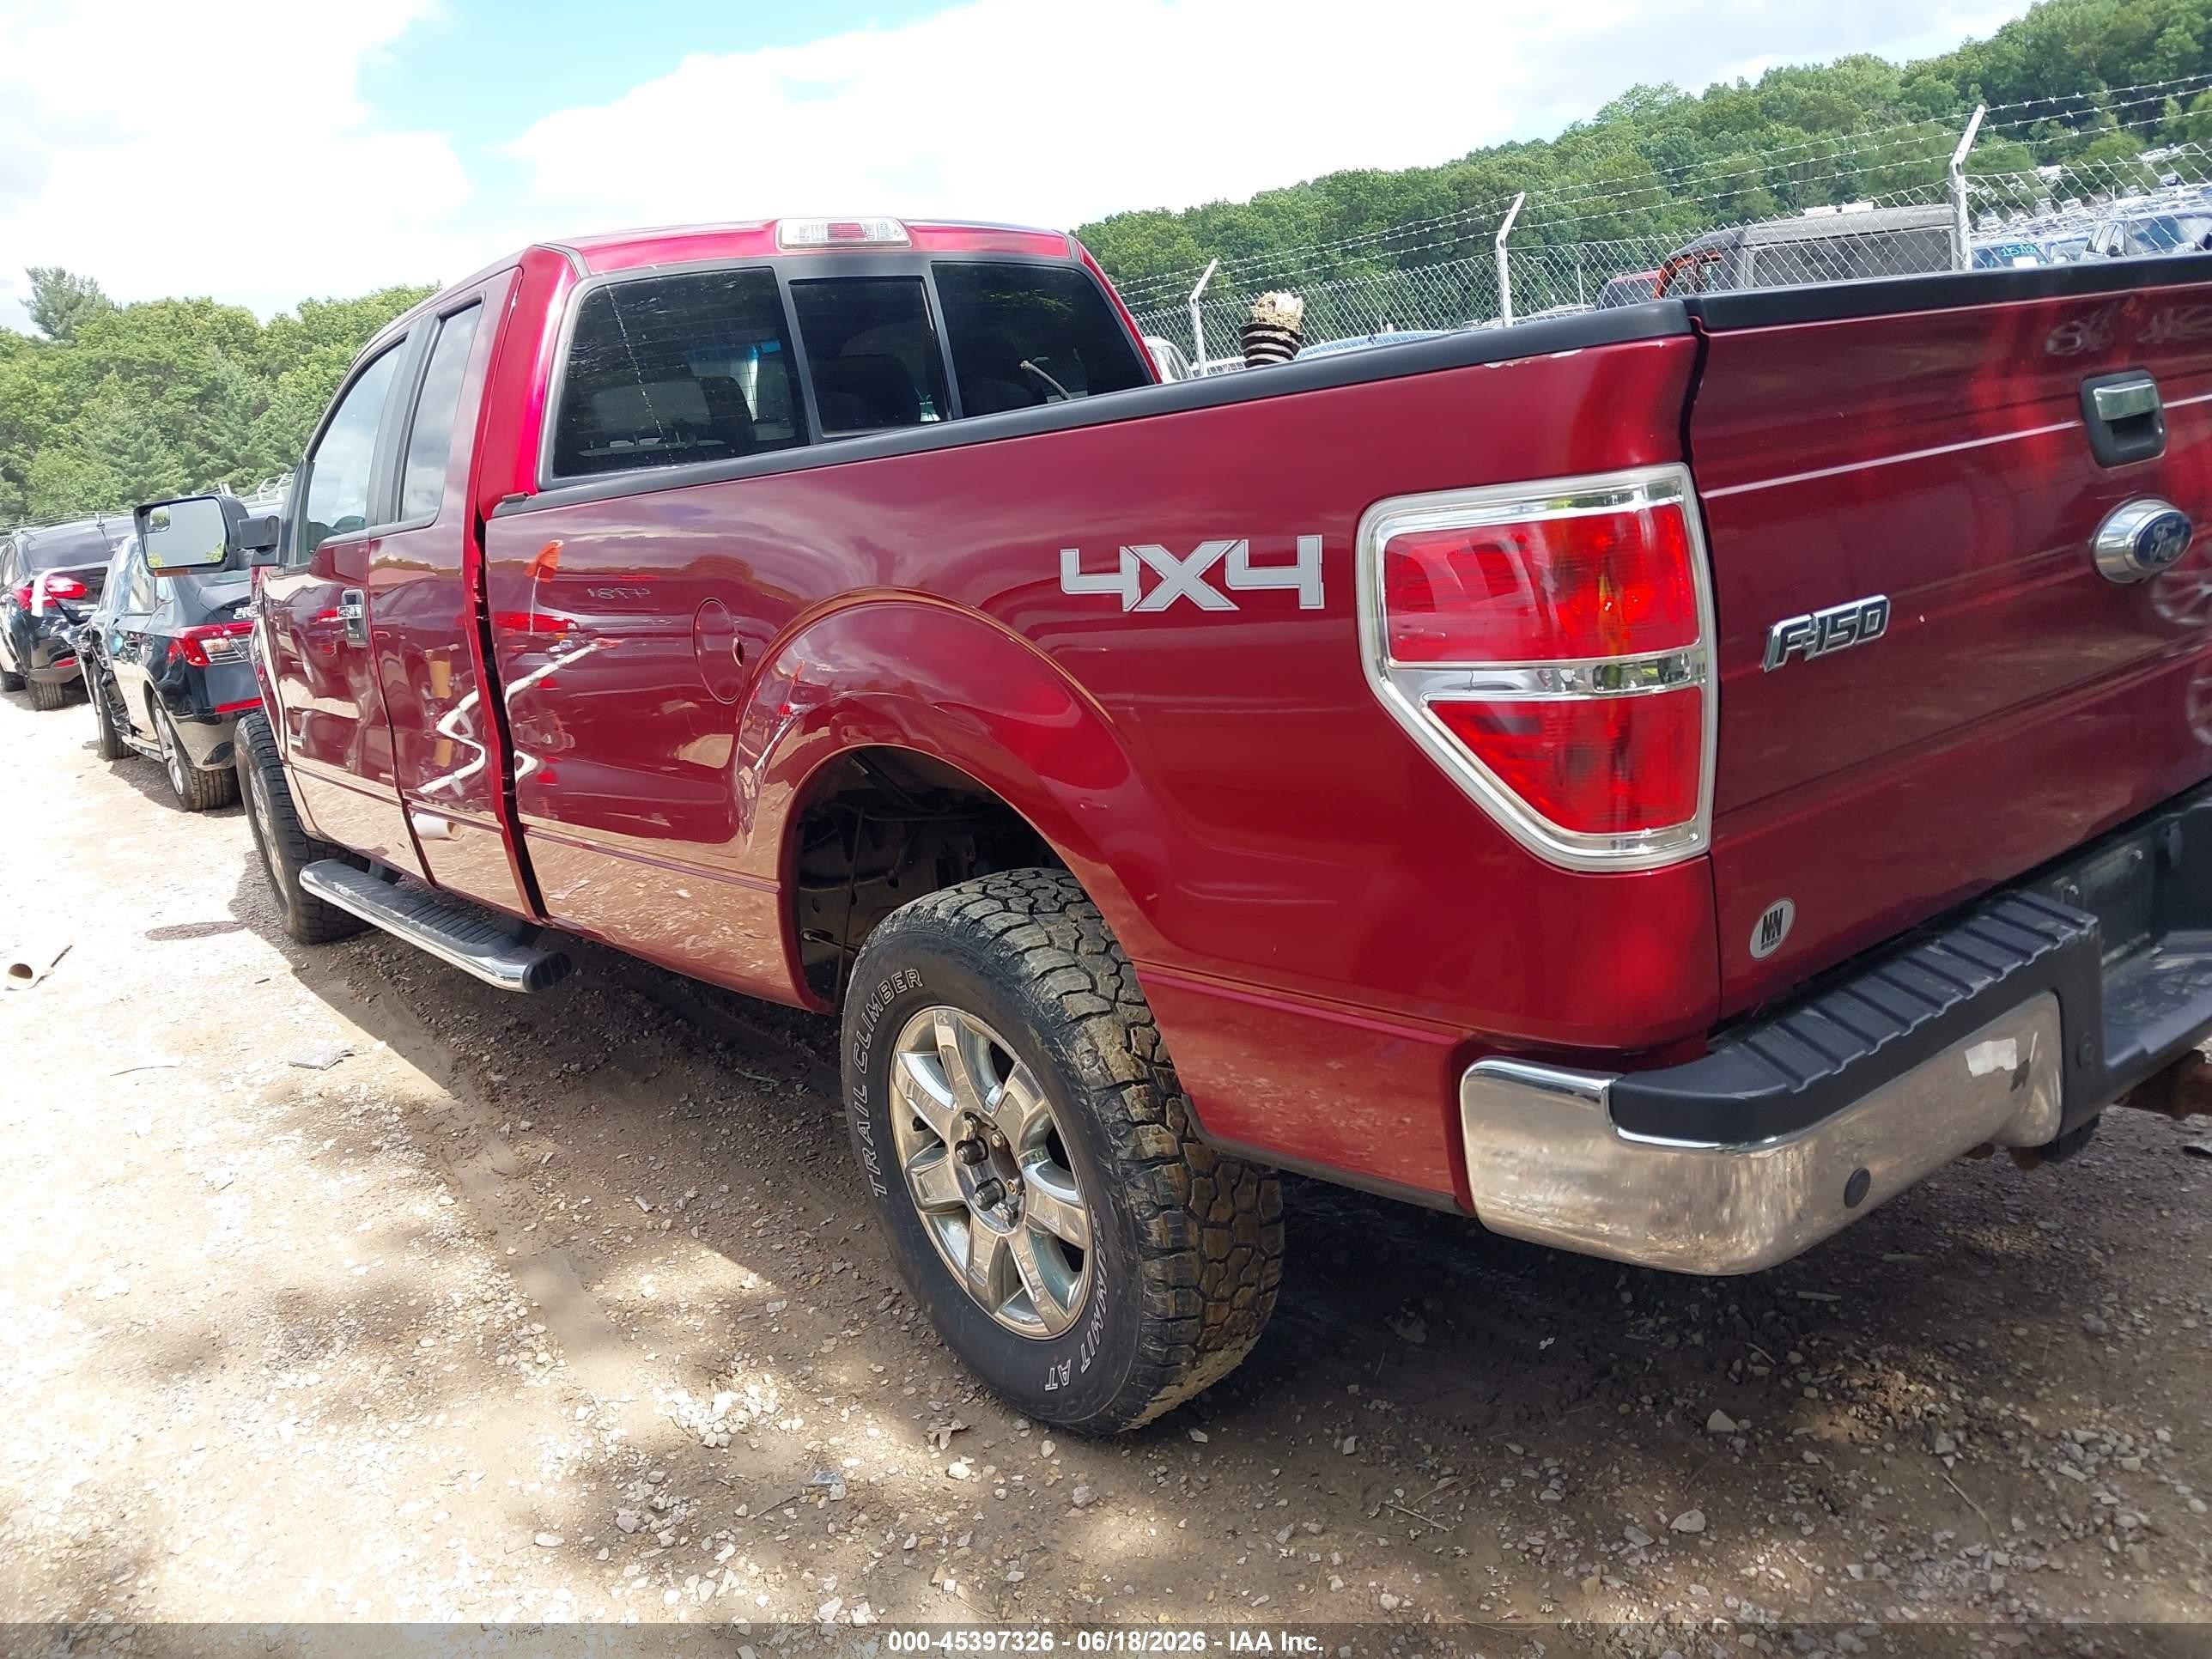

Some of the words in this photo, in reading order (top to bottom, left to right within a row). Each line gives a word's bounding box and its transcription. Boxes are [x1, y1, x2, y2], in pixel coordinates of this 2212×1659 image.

[1763, 594, 1890, 672] F-150
[853, 969, 923, 1074] CLIMBER
[854, 1085, 888, 1197] TRAIL
[1080, 1205, 1108, 1373] SUMMIT
[1045, 1359, 1072, 1391] AT
